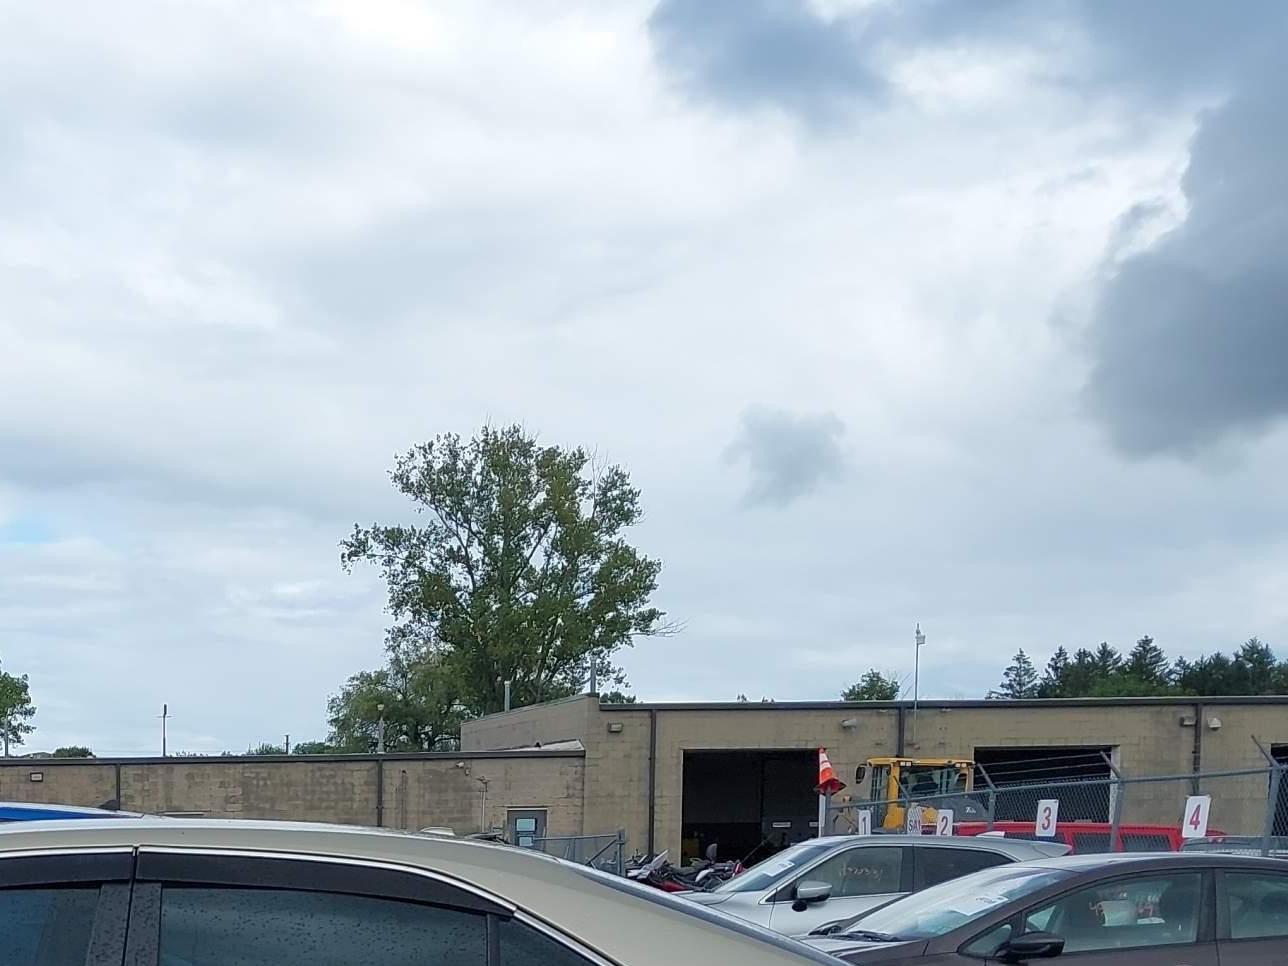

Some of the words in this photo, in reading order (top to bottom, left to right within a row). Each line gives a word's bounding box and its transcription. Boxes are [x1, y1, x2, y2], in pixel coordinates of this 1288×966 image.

[941, 815, 949, 835] 2
[1041, 806, 1052, 830] 3
[1189, 804, 1201, 830] 4
